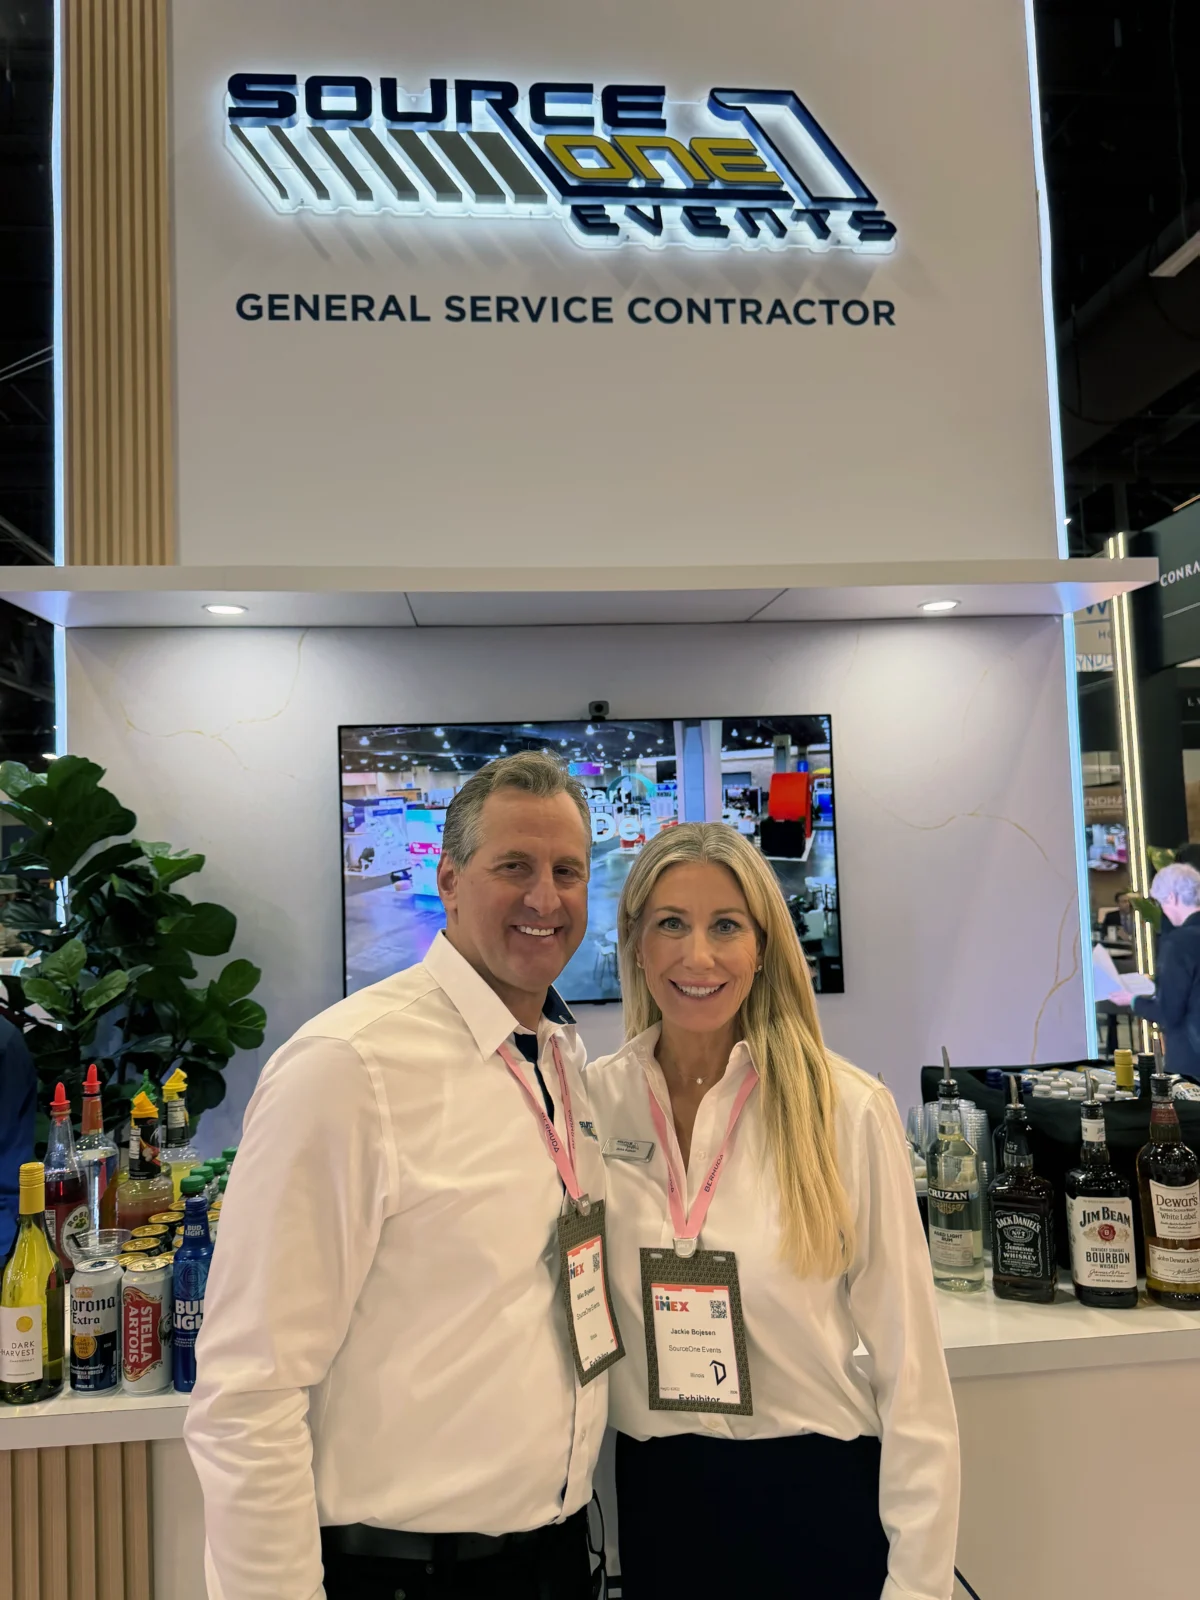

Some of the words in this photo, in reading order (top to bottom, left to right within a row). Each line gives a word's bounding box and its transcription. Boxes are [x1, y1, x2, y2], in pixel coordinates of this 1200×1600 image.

[228, 73, 666, 129] SOURCE
[570, 204, 897, 241] EVENTS
[236, 293, 431, 322] GENERAL
[445, 295, 614, 323] SERVICE
[627, 297, 896, 326] CONTRACTOR
[928, 1187, 968, 1200] CRUZAN
[1155, 1194, 1198, 1208] Dewar's
[996, 1215, 1013, 1229] JACK
[1079, 1209, 1100, 1228] JIM
[1003, 1252, 1037, 1261] WHISKEY
[1085, 1251, 1130, 1264] BOURBON
[71, 1312, 100, 1325] Extra
[128, 1306, 139, 1364] ARTOIS
[140, 1306, 152, 1363] STELLA
[691, 1328, 716, 1337] Bojesen
[12, 1340, 35, 1349] DARK
[668, 1344, 701, 1354] SourceOne
